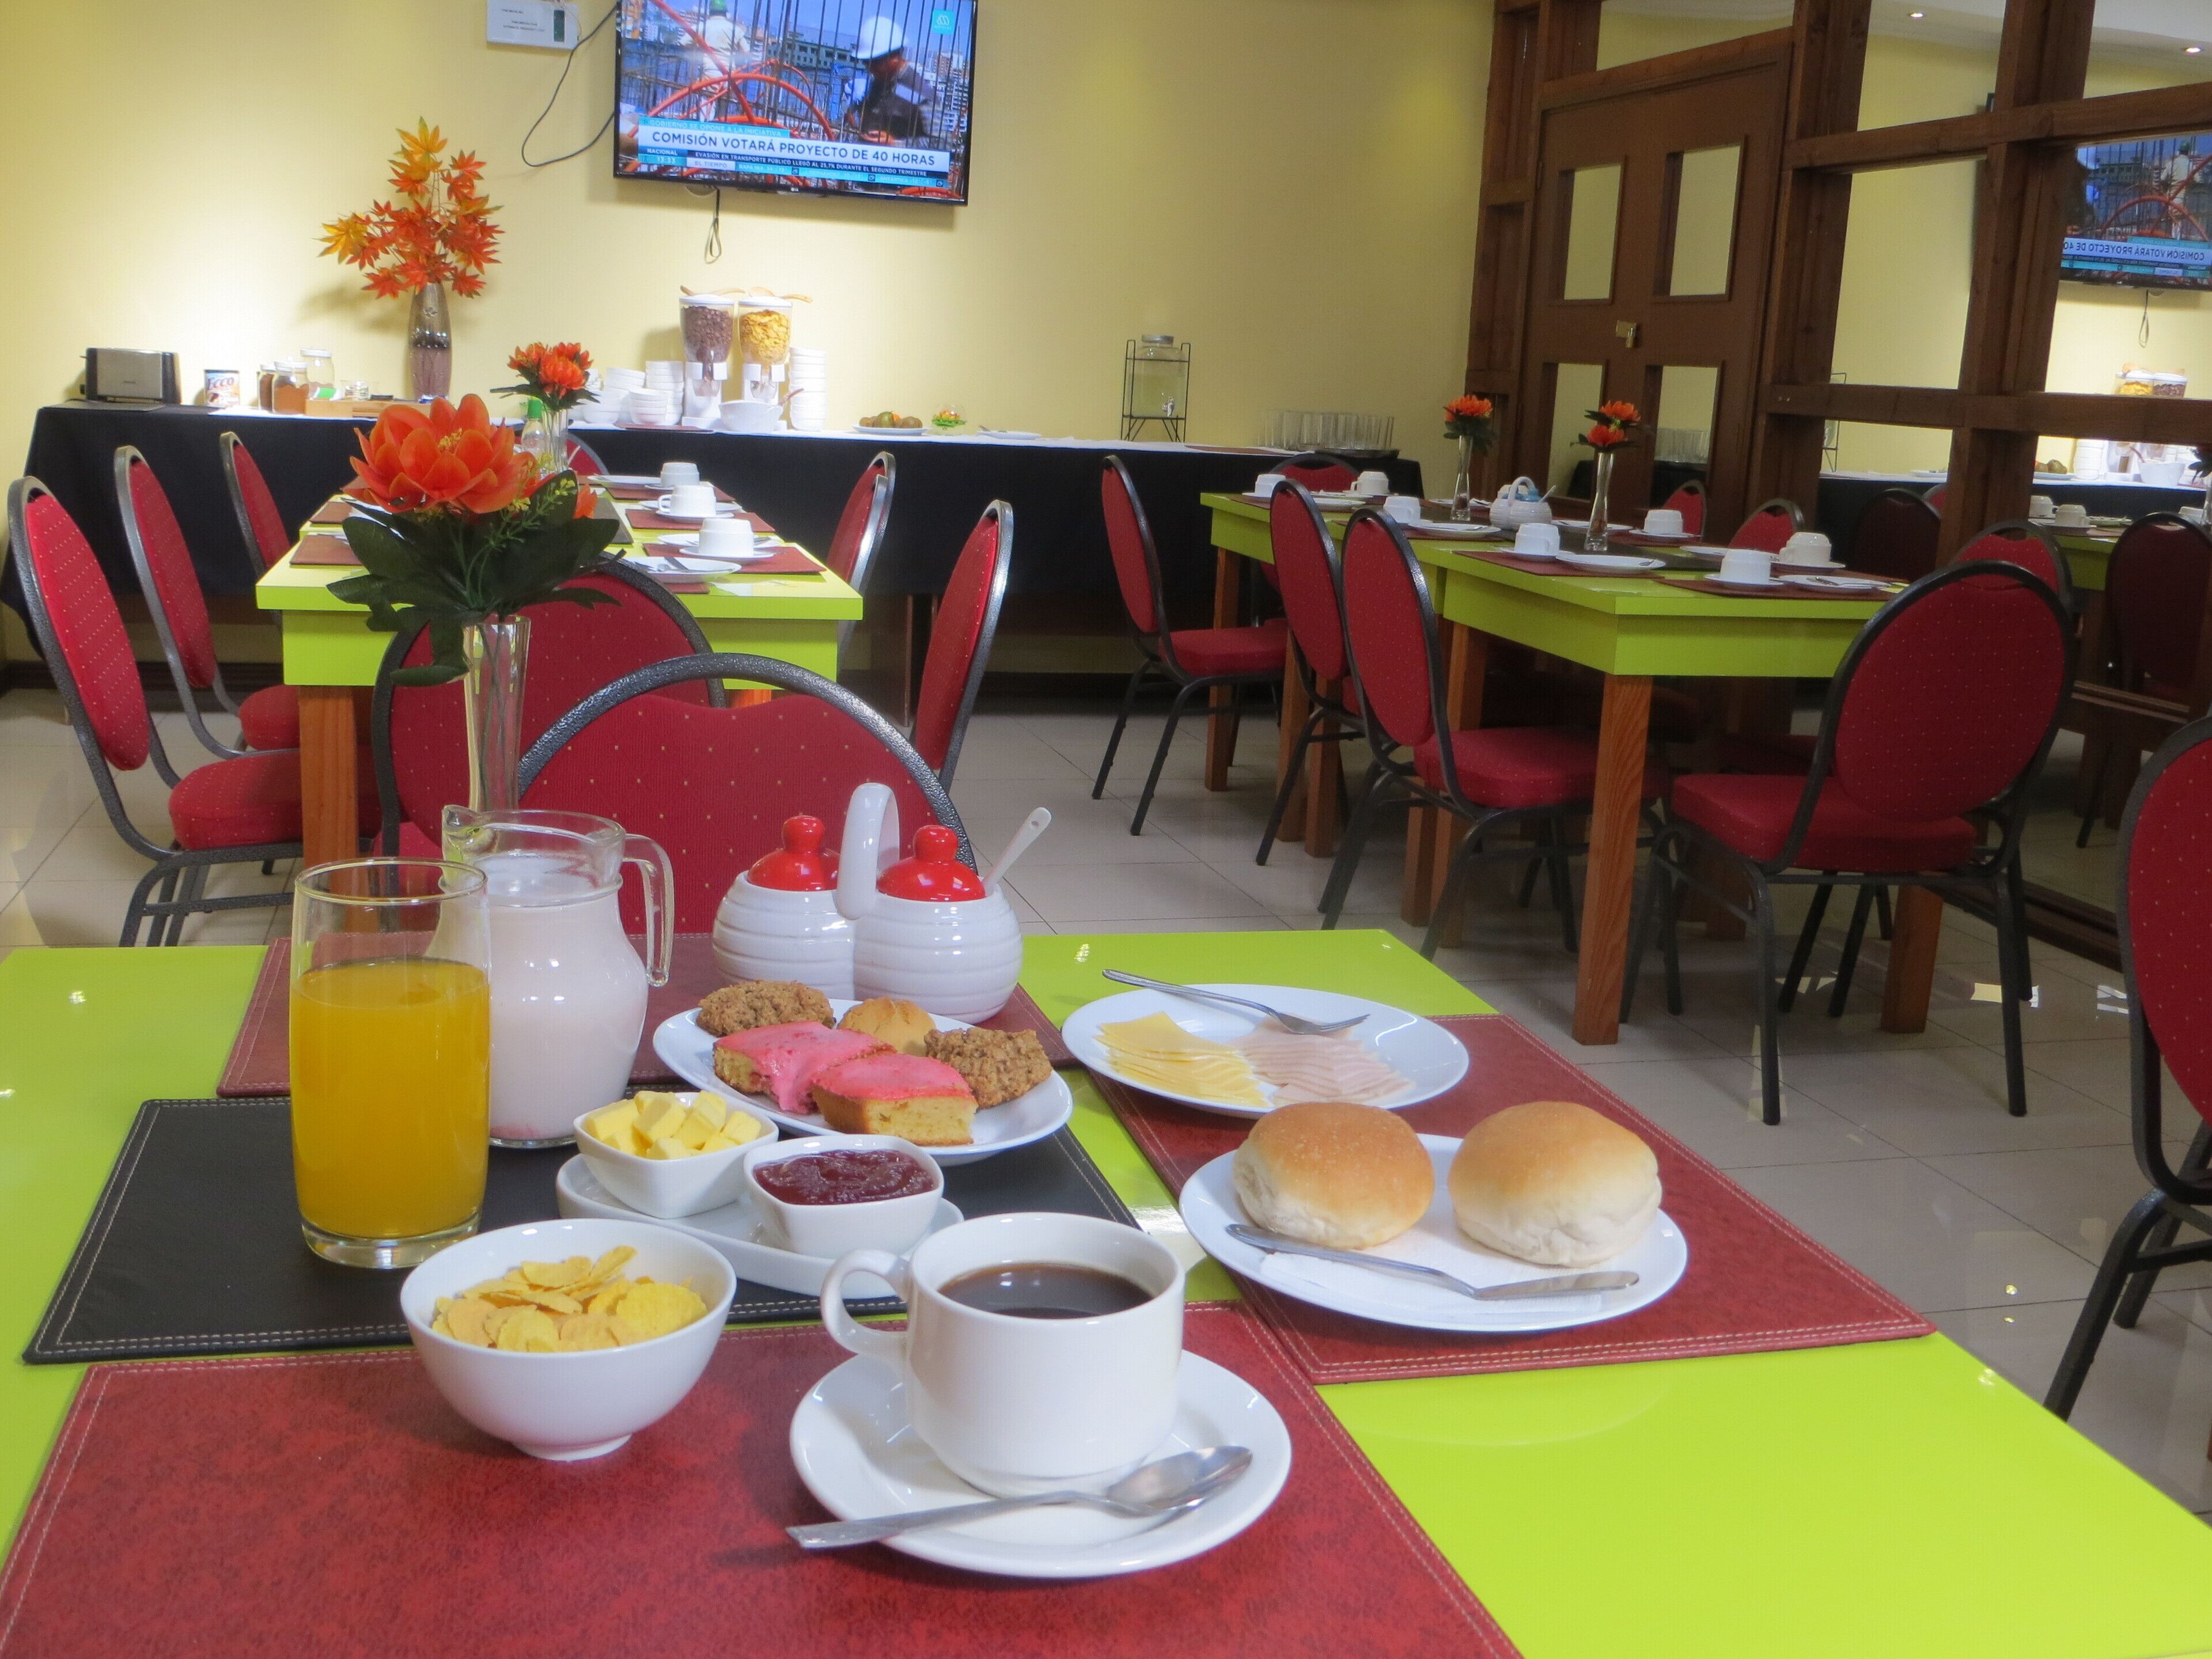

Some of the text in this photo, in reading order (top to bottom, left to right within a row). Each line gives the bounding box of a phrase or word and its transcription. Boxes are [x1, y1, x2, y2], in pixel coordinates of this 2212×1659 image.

[650, 119, 688, 128] GOBIERNO
[745, 128, 782, 137] INICIATIVA
[652, 131, 935, 166] COMISIÓN VOTARÁ PROYECTO DE 40 HORAS
[898, 169, 927, 177] TRIMESTRE
[207, 377, 234, 391] Ecco
